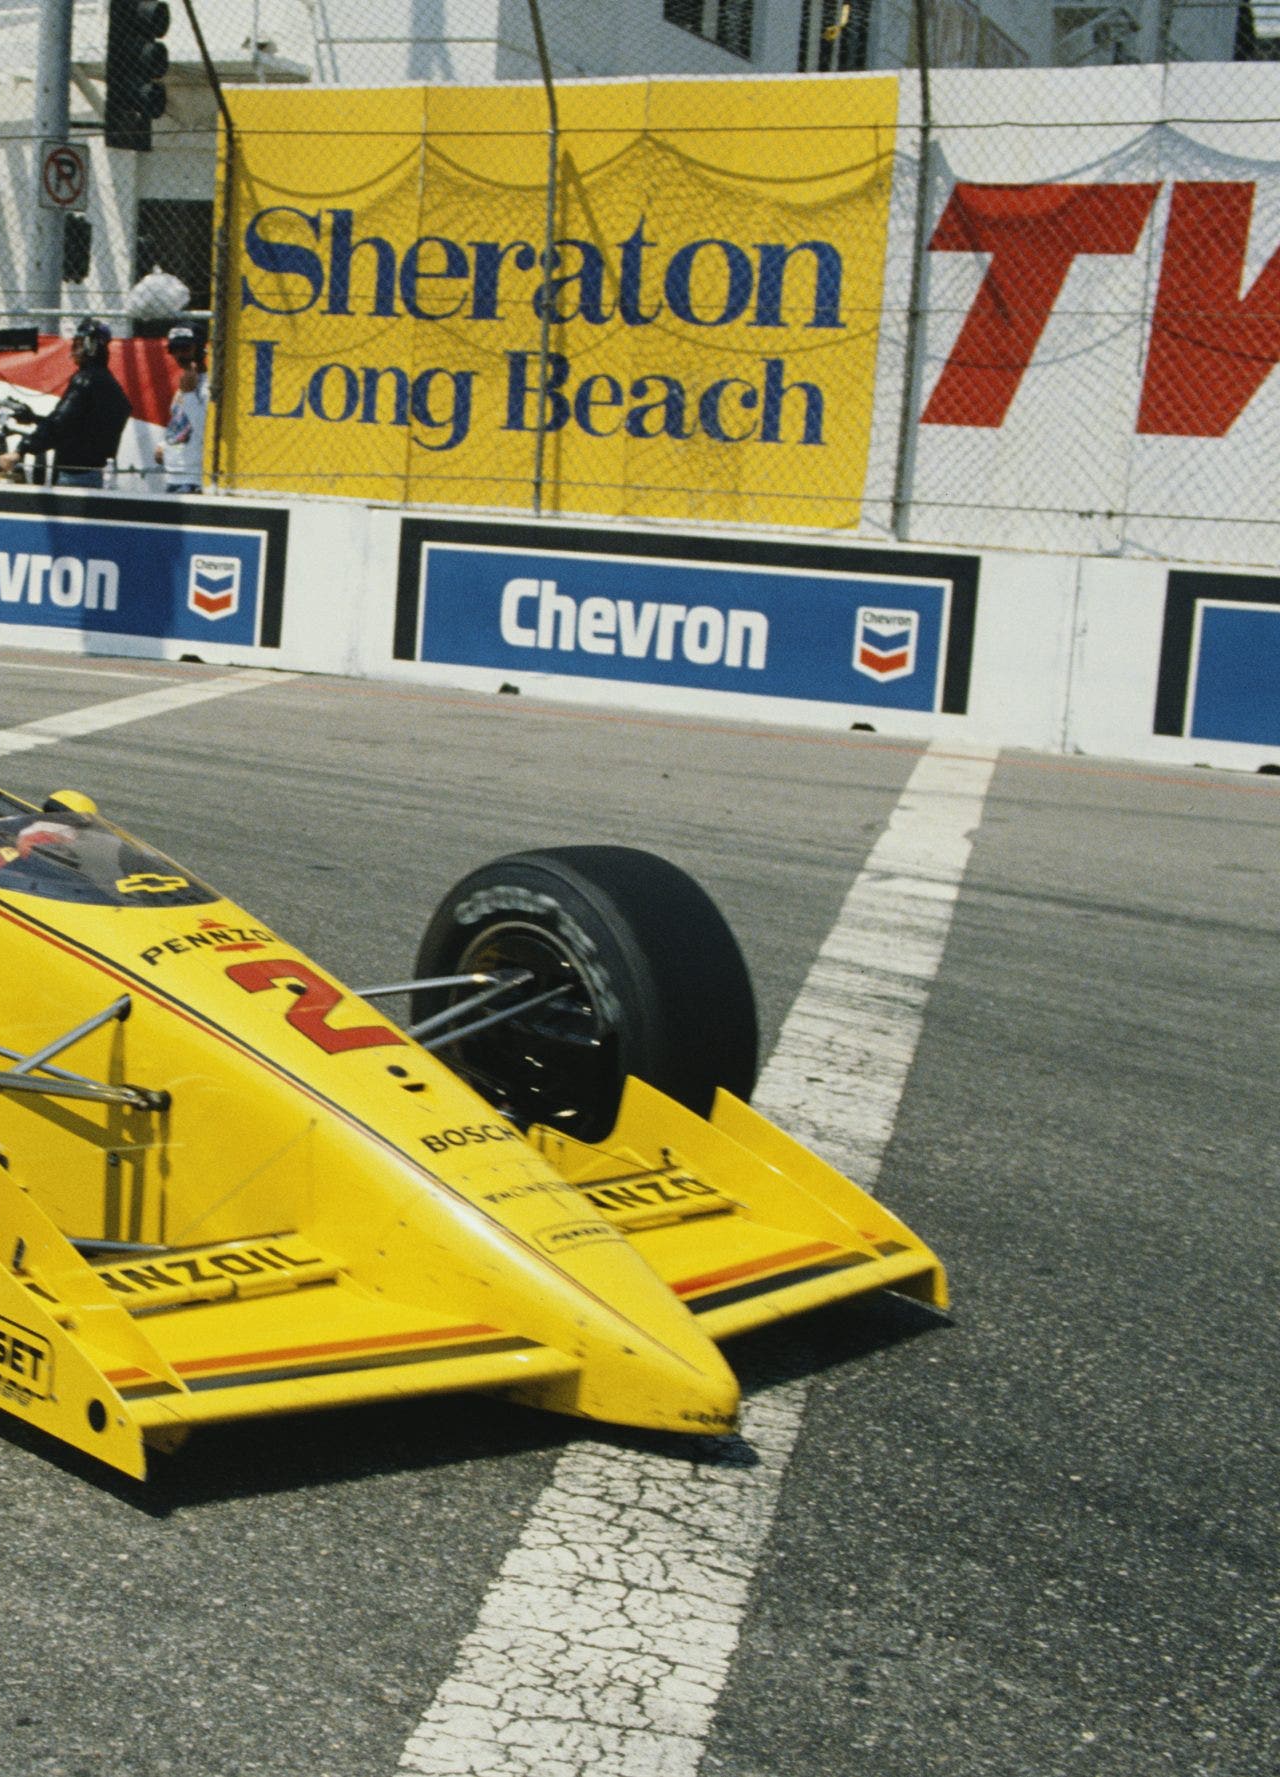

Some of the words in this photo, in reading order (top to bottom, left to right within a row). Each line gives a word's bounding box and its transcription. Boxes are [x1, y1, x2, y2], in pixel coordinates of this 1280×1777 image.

[241, 206, 847, 328] Sheraton
[248, 341, 479, 451] Long
[500, 350, 826, 446] Beach
[500, 577, 768, 670] Chevron
[863, 612, 912, 626] Chevron
[224, 958, 410, 1055] 2
[420, 1123, 518, 1155] BOSCH
